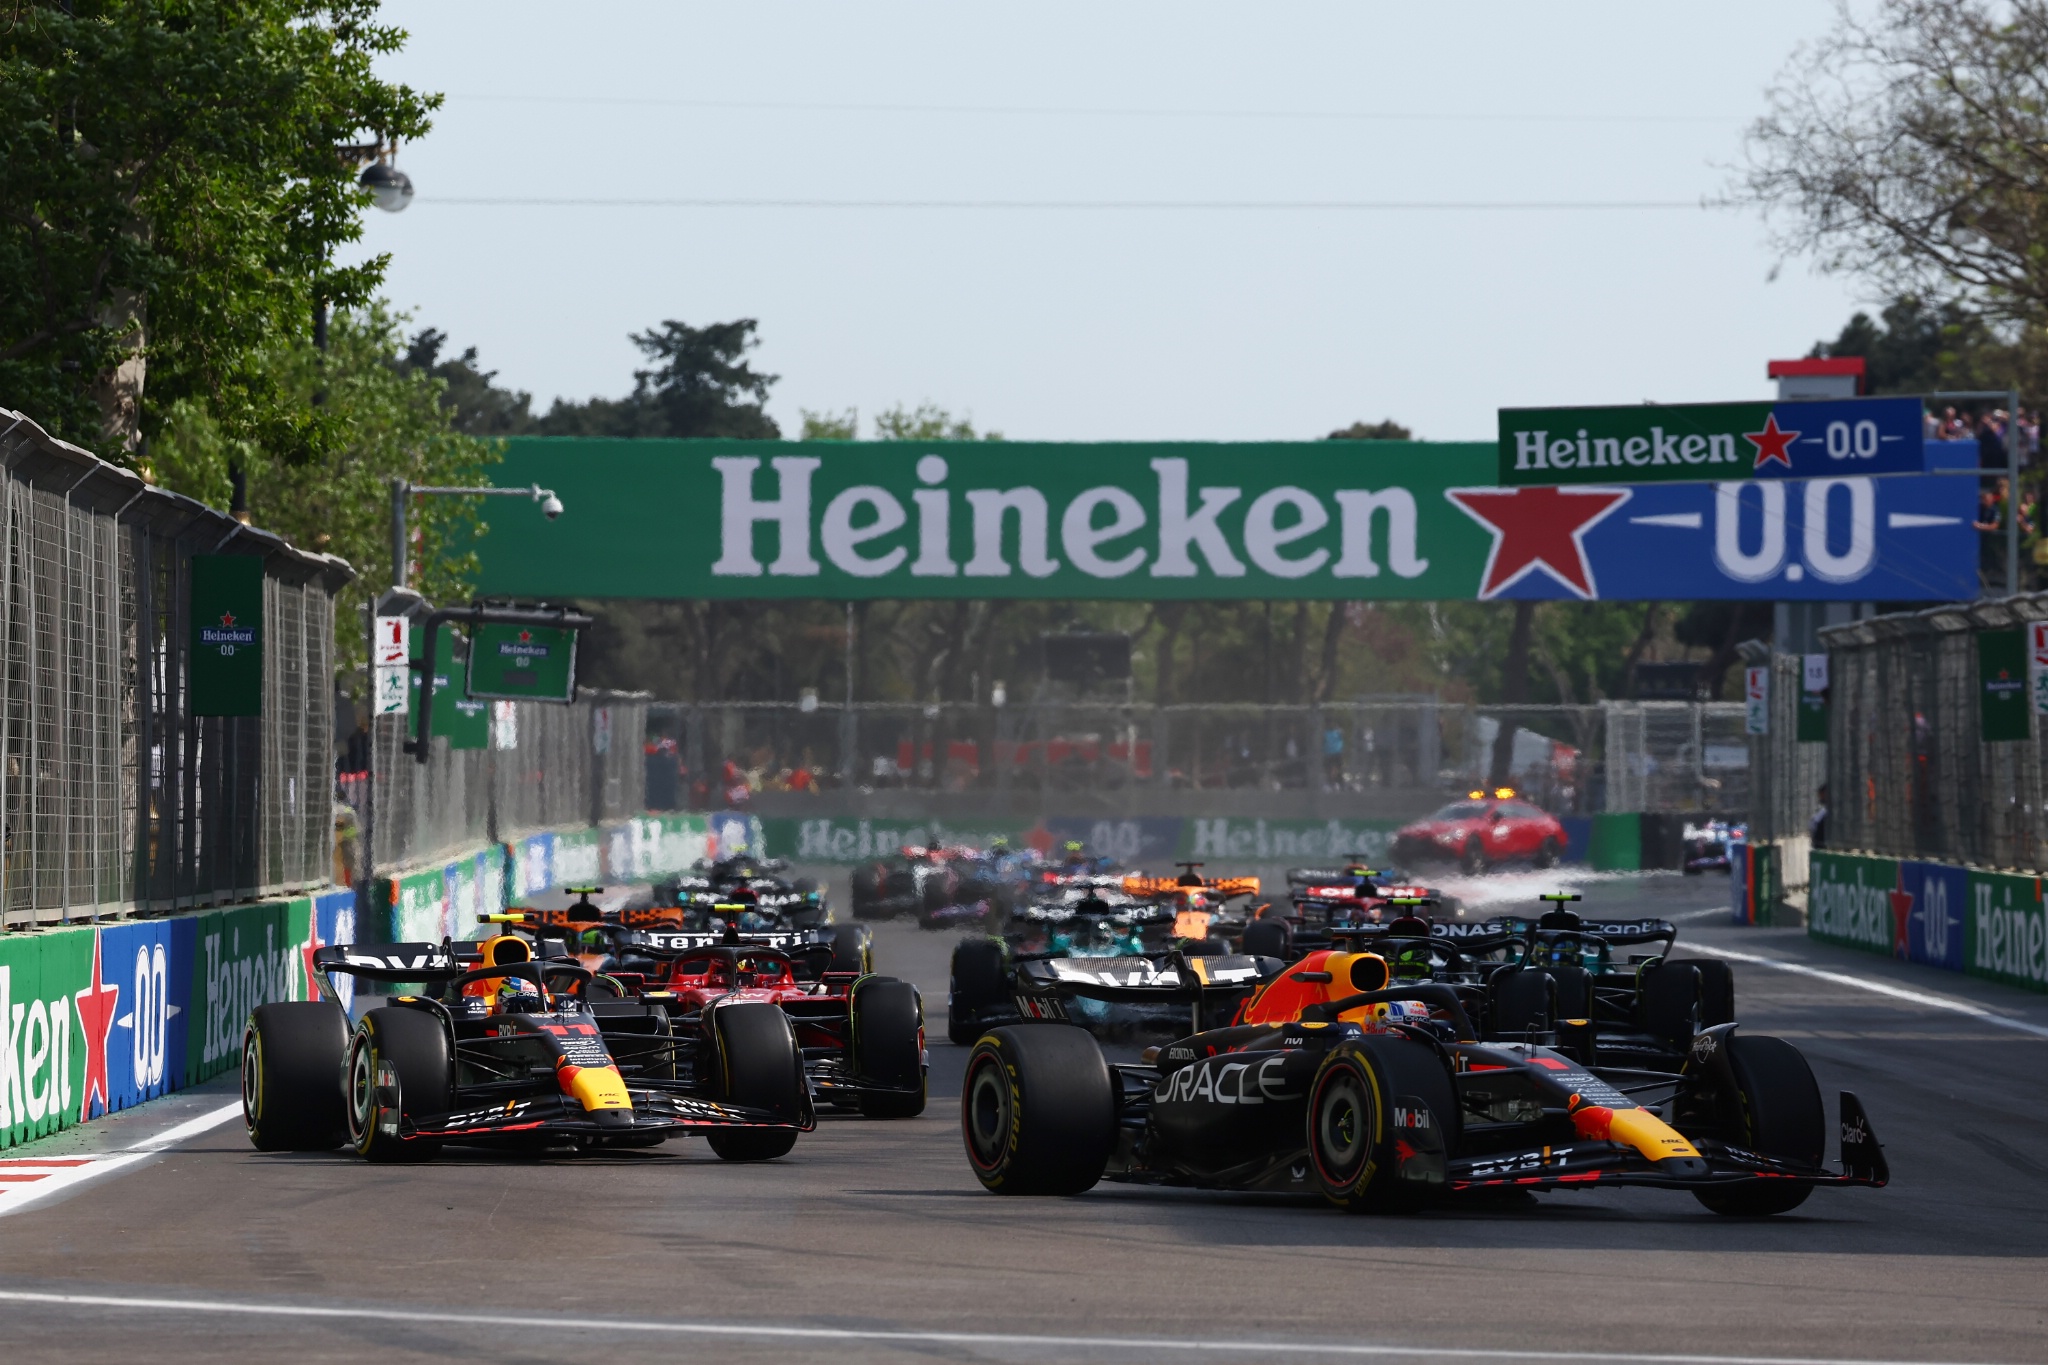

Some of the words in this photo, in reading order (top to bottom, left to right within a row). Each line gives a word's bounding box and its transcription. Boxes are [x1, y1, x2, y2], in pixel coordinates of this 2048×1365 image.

[1513, 427, 1738, 471] Heineken
[1826, 420, 1879, 460] 0.0
[711, 453, 1428, 578] Heineken
[1713, 477, 1877, 584] 0.0
[203, 629, 253, 641] Heineken
[1811, 861, 1890, 946] Heineken
[134, 943, 167, 1092] 0.0
[1015, 995, 1056, 1019] Mobil
[538, 1024, 598, 1035] 11
[1168, 1047, 1198, 1060] HONDA
[1525, 1057, 1570, 1070] 1
[1010, 1083, 1021, 1153] ZERO
[1394, 1107, 1430, 1129] Mobil
